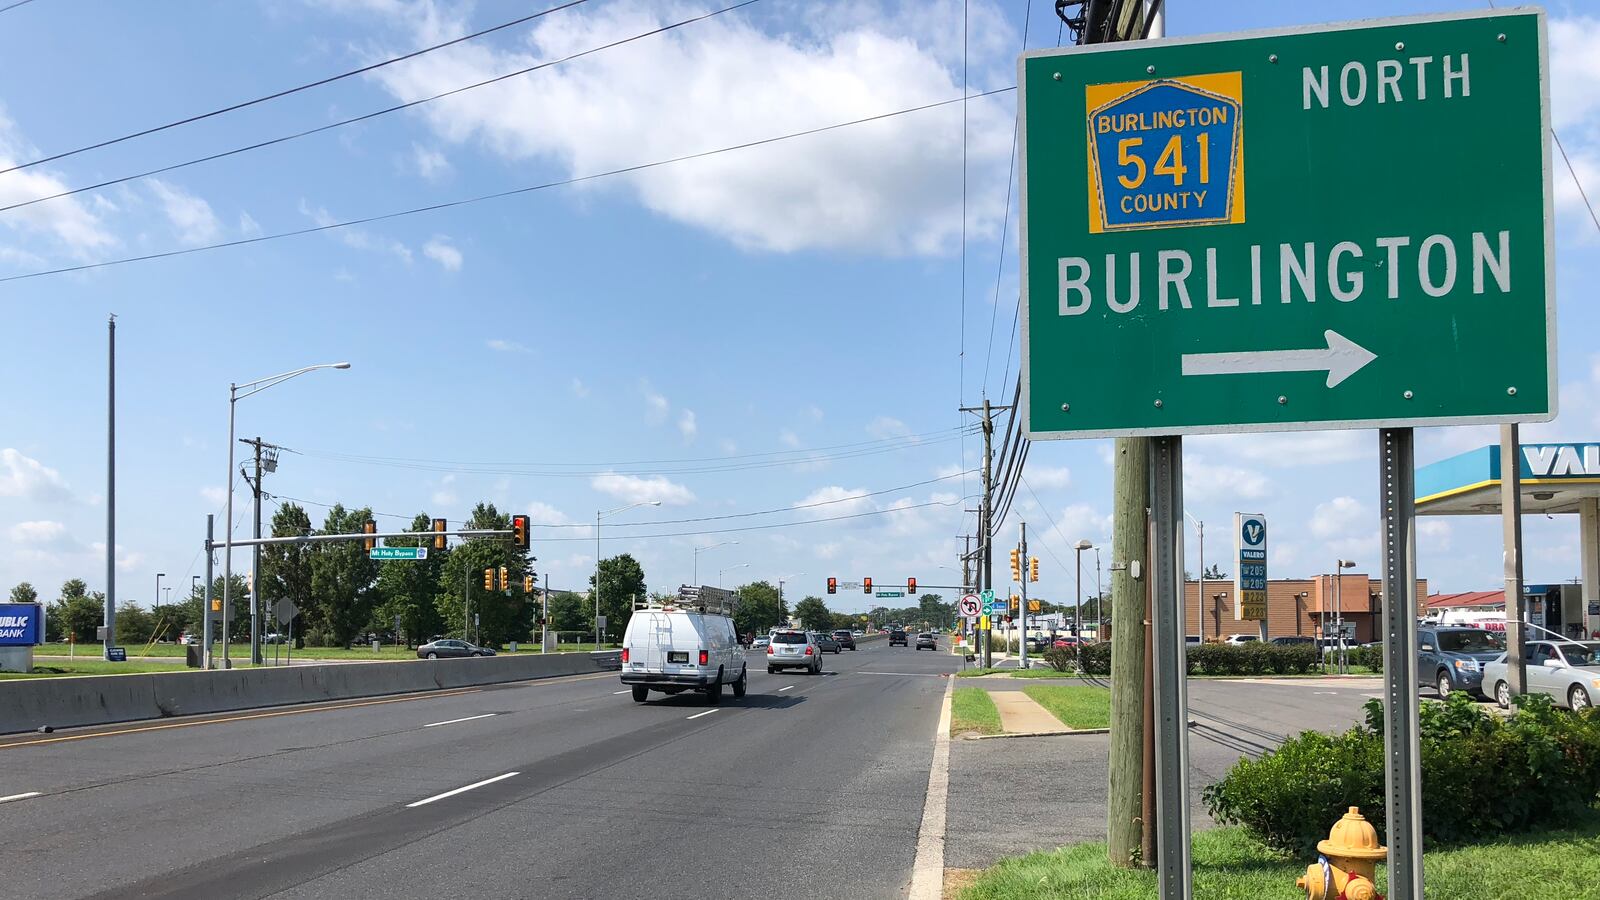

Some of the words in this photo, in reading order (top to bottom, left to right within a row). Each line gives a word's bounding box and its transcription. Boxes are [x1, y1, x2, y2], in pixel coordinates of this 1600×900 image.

[1302, 53, 1471, 110] NORTH
[1098, 106, 1227, 134] BURLINGTON
[1117, 132, 1209, 189] 541
[1120, 190, 1207, 214] COUNTY
[1057, 230, 1511, 316] BURLINGTON
[1522, 446, 1600, 475] VAL
